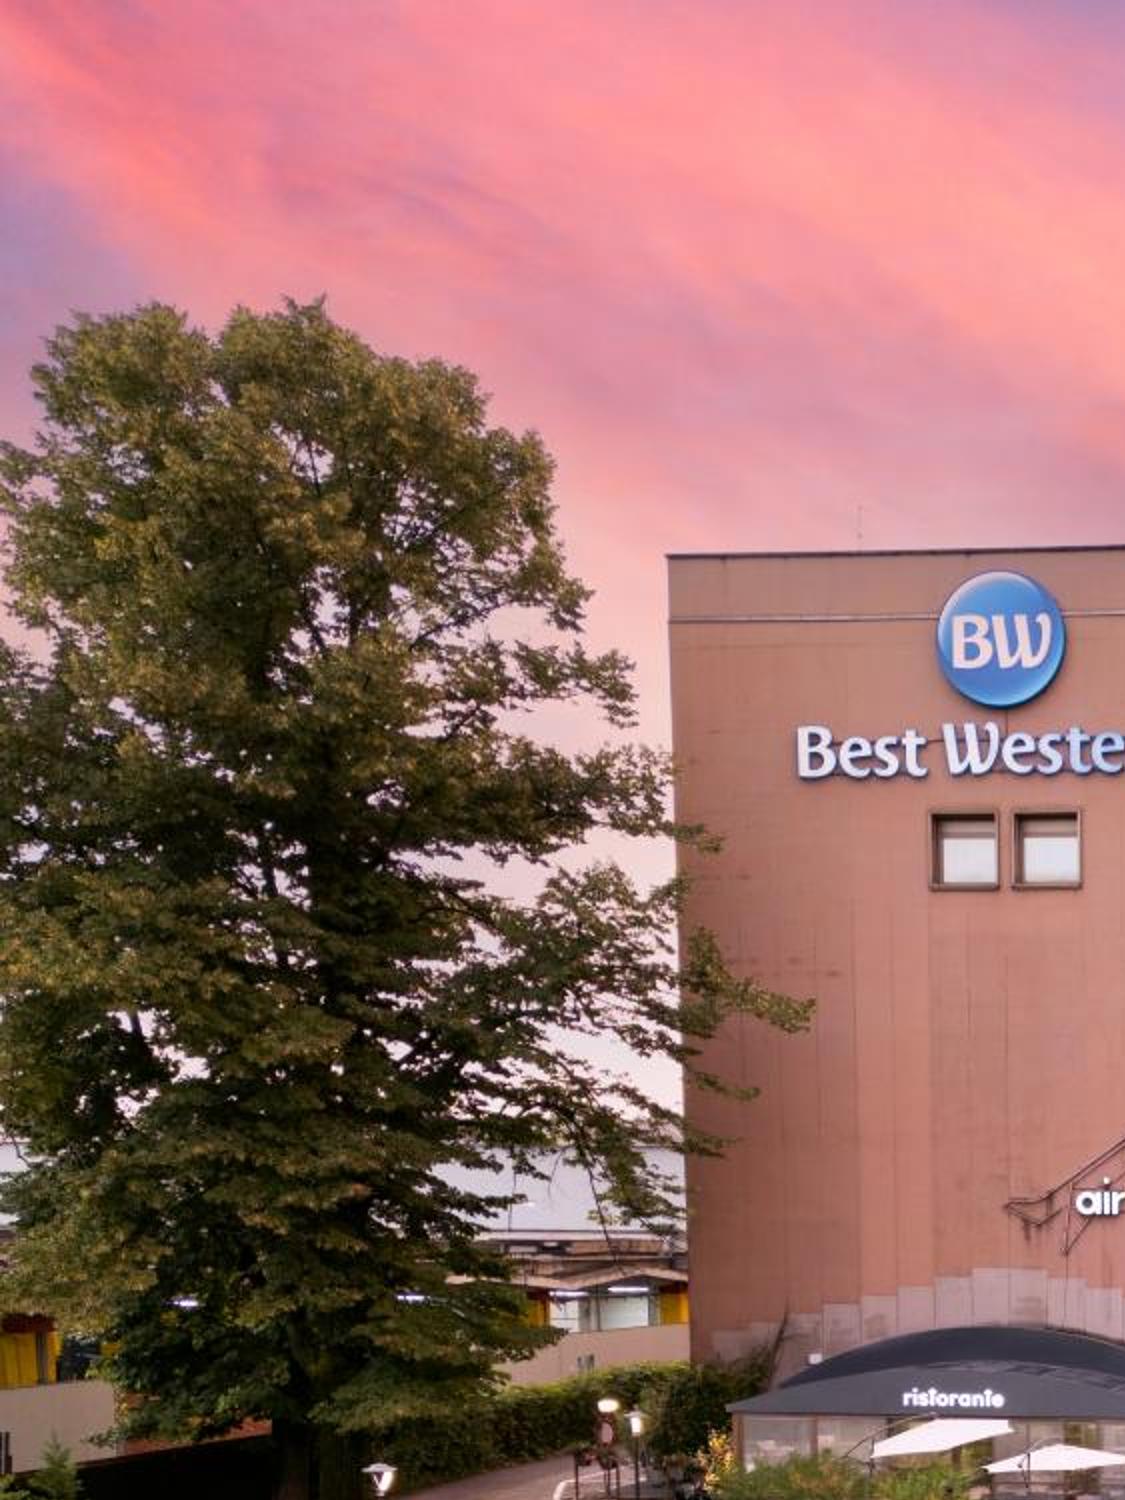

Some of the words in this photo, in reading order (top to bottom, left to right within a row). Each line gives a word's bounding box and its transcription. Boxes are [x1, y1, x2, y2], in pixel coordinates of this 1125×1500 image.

[952, 612, 1051, 670] BW
[796, 724, 928, 779] Best
[903, 1387, 1005, 1408] ristorante
